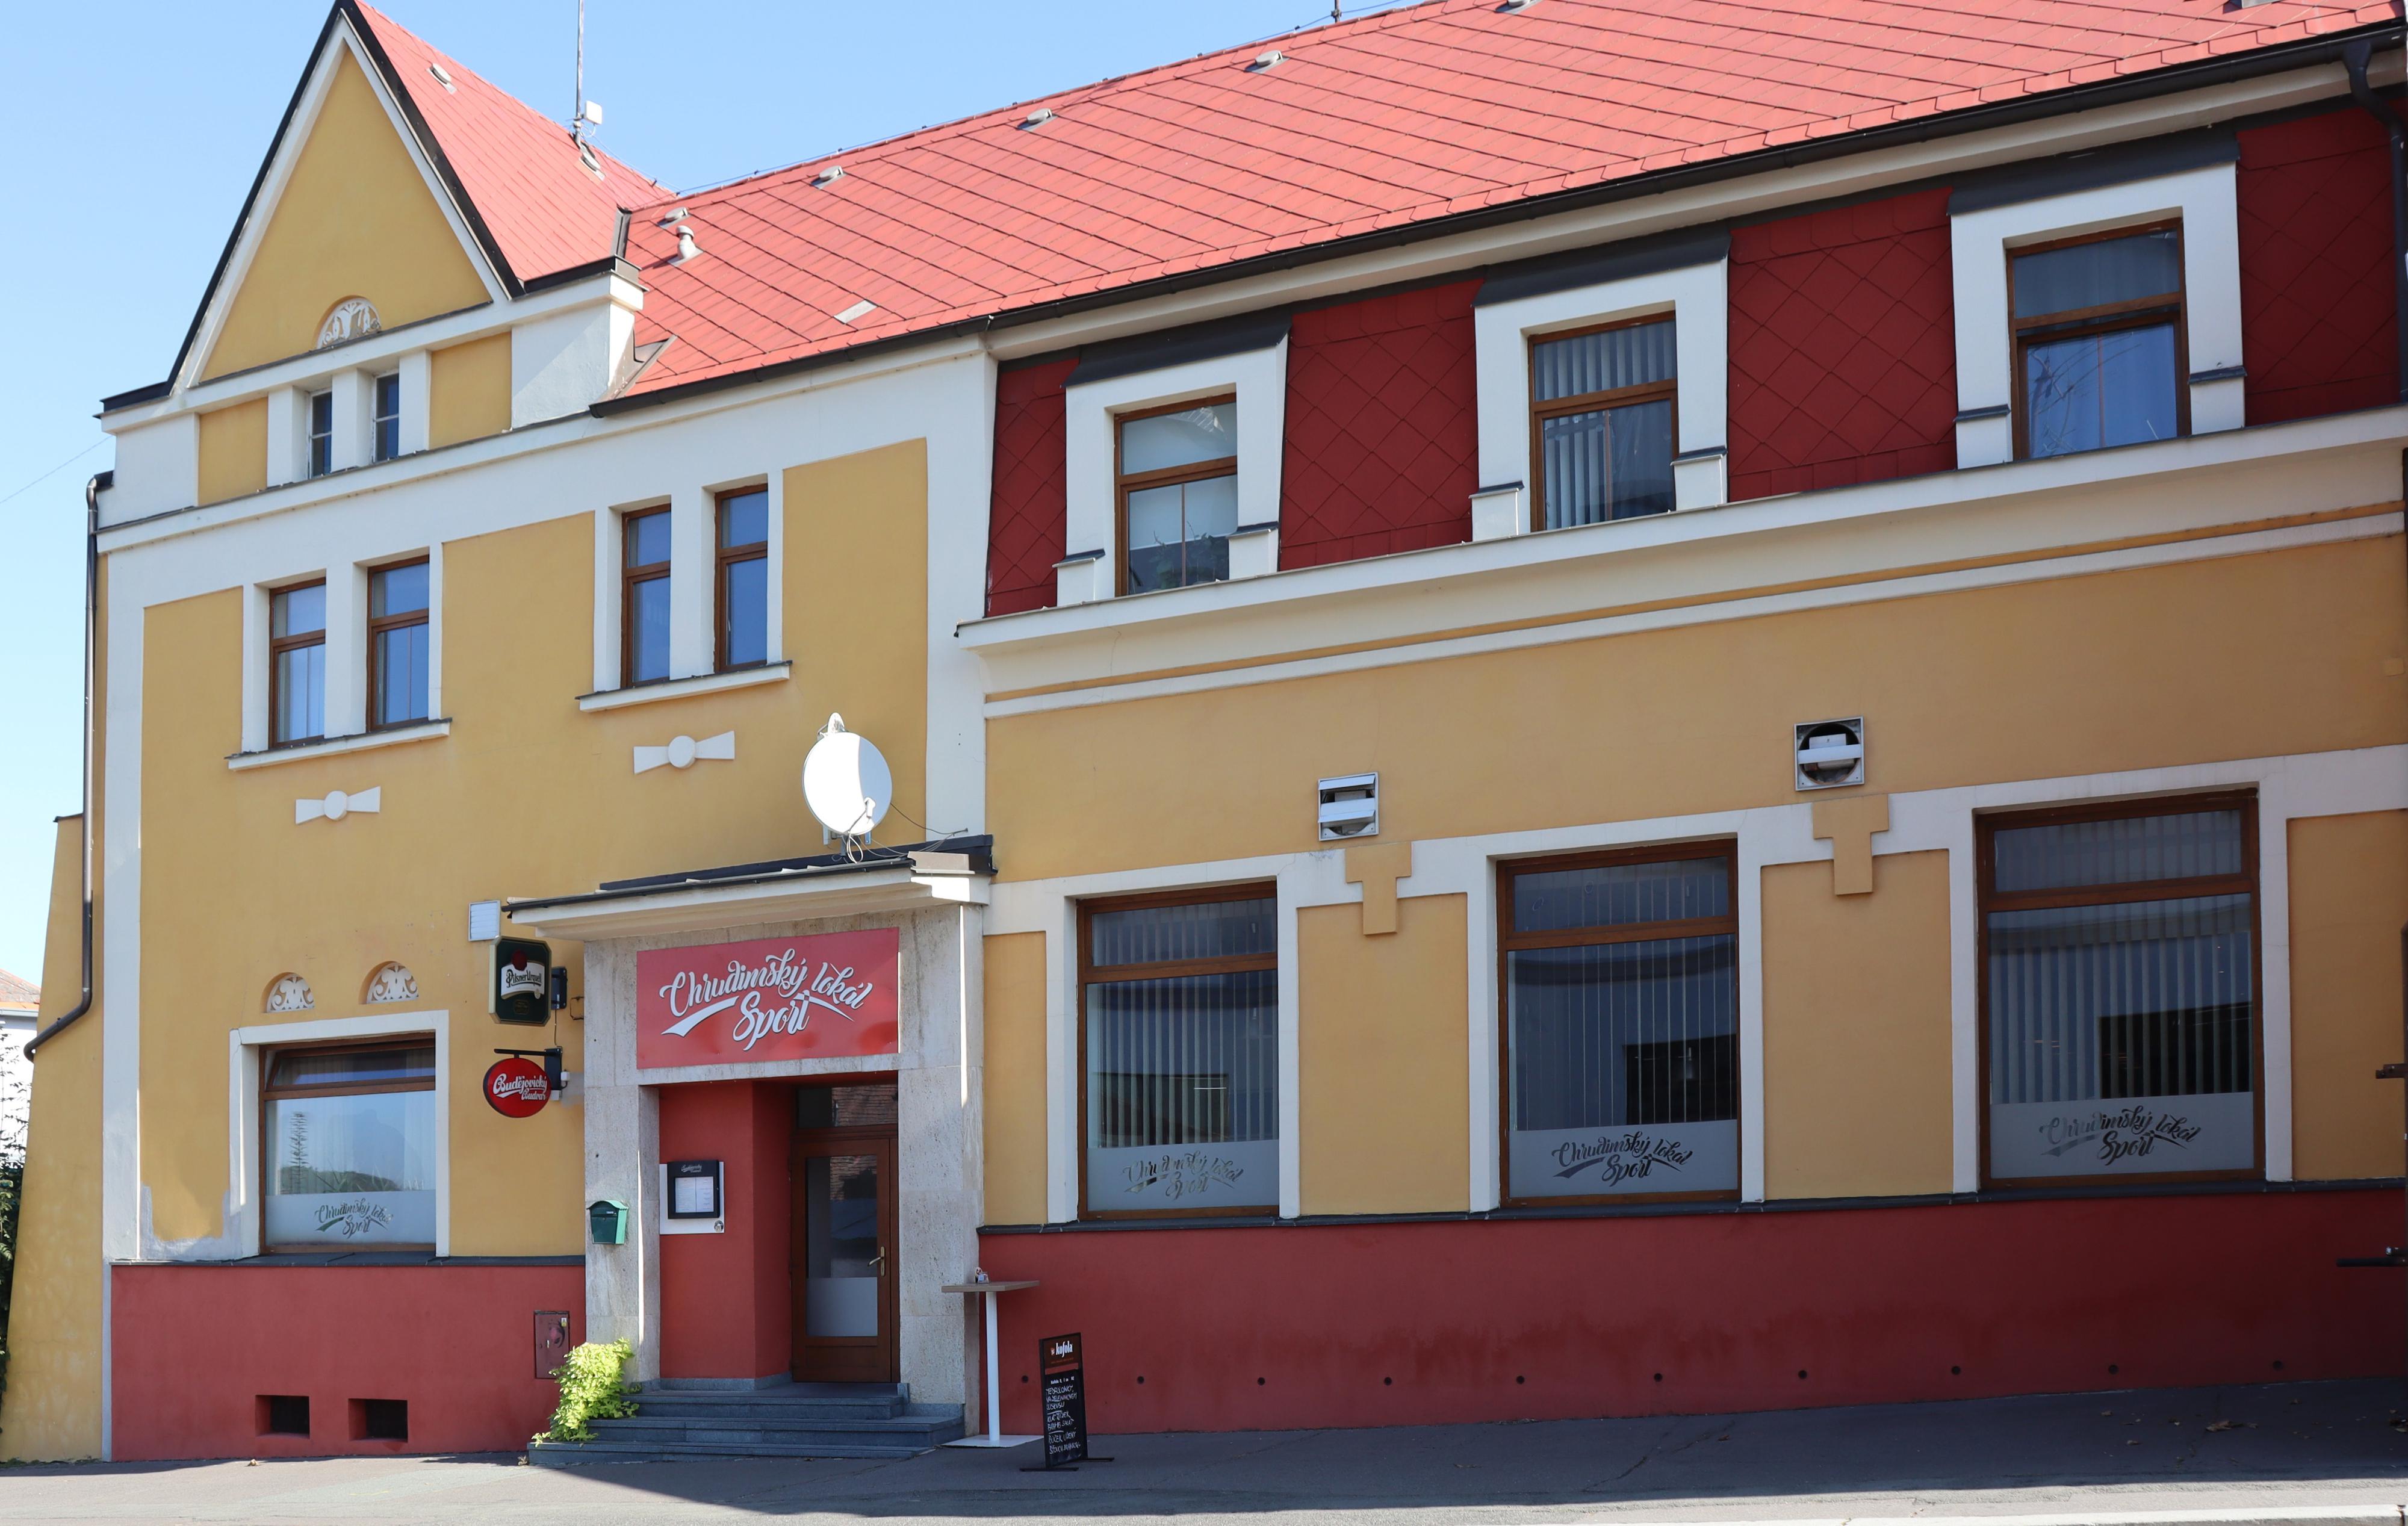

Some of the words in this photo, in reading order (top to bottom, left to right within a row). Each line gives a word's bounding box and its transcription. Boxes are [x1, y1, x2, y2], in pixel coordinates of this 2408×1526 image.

[506, 969, 527, 988] Pilsner
[660, 948, 807, 1017] Chrudimský
[811, 962, 873, 1010] lokál
[732, 990, 811, 1052] Sport
[492, 1073, 547, 1094] Budějovický
[2039, 1105, 2153, 1144] Chrudimský
[2155, 1114, 2202, 1143] lokál
[1551, 1131, 1651, 1167] Chrudimský
[1653, 1138, 1693, 1165] lokál
[2096, 1130, 2156, 1166] Sport
[1601, 1153, 1653, 1187] Sport
[314, 1198, 371, 1224] Chrudimský
[342, 1214, 371, 1239] Sport
[1055, 1340, 1073, 1358] kofola
